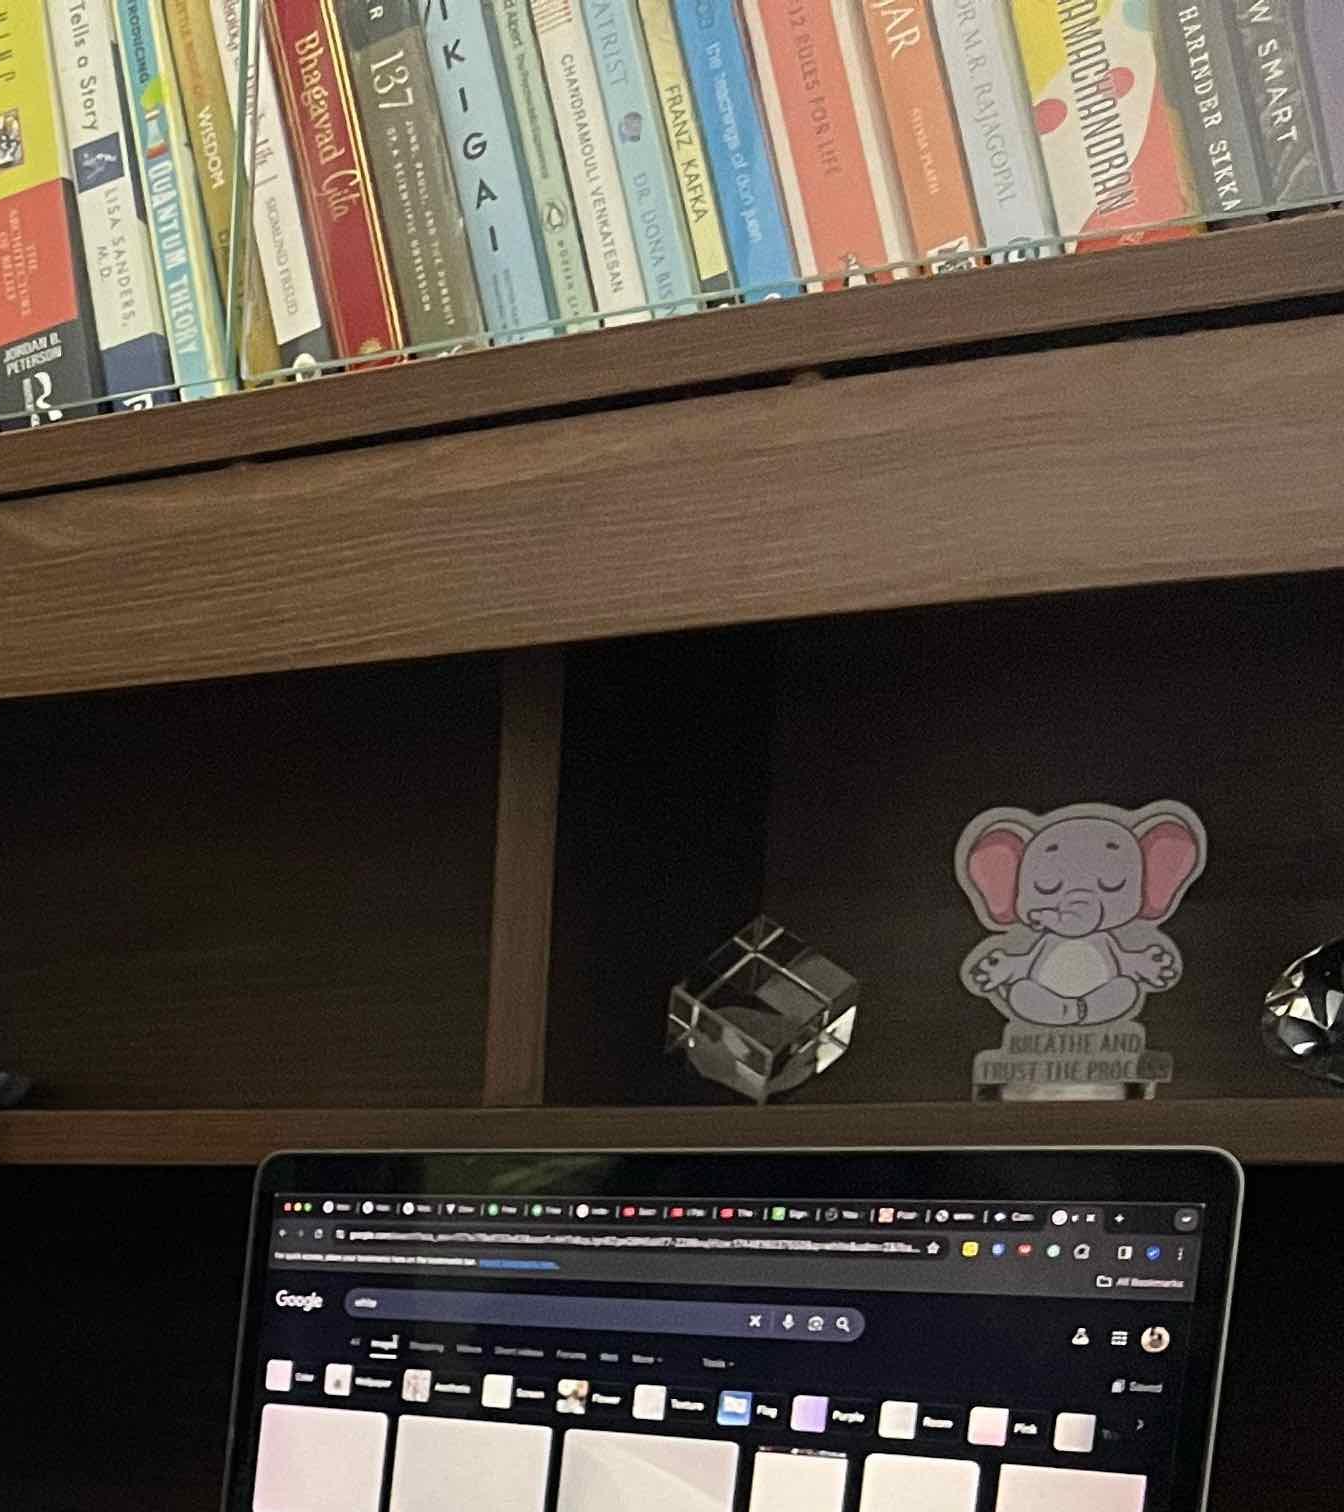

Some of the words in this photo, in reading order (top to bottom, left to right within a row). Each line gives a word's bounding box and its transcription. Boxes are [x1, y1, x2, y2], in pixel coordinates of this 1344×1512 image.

[69, 3, 90, 48] Tells
[77, 56, 88, 68] a
[370, 50, 414, 109] 137
[798, 33, 822, 92] RULES
[80, 75, 100, 131] Story
[294, 30, 345, 165] Bhagavad
[808, 97, 831, 136] FOR
[1057, 0, 1137, 216] AMACHANDRAN
[1178, 6, 1223, 129] HARINDER
[1208, 140, 1242, 212] SIKKA
[1257, 38, 1299, 144] SMART
[196, 105, 225, 190] WISDOM
[561, 53, 599, 183] CHANDRAMOULI
[589, 184, 624, 293] VENKATESAN
[665, 84, 692, 149] FRANZ
[681, 158, 710, 222] KAFKA
[817, 136, 843, 176] LIFE
[975, 82, 1017, 210] RAJAGOPAL
[316, 169, 361, 222] Gita
[148, 162, 187, 270] QUANTUM
[168, 274, 200, 354] THEORY
[3, 336, 48, 364] JORDAN
[6, 345, 62, 376] PETERSON
[983, 1060, 1037, 1082] TRUST
[1047, 1060, 1080, 1082] THE
[1102, 1033, 1142, 1053] AND
[275, 1289, 324, 1313] Google
